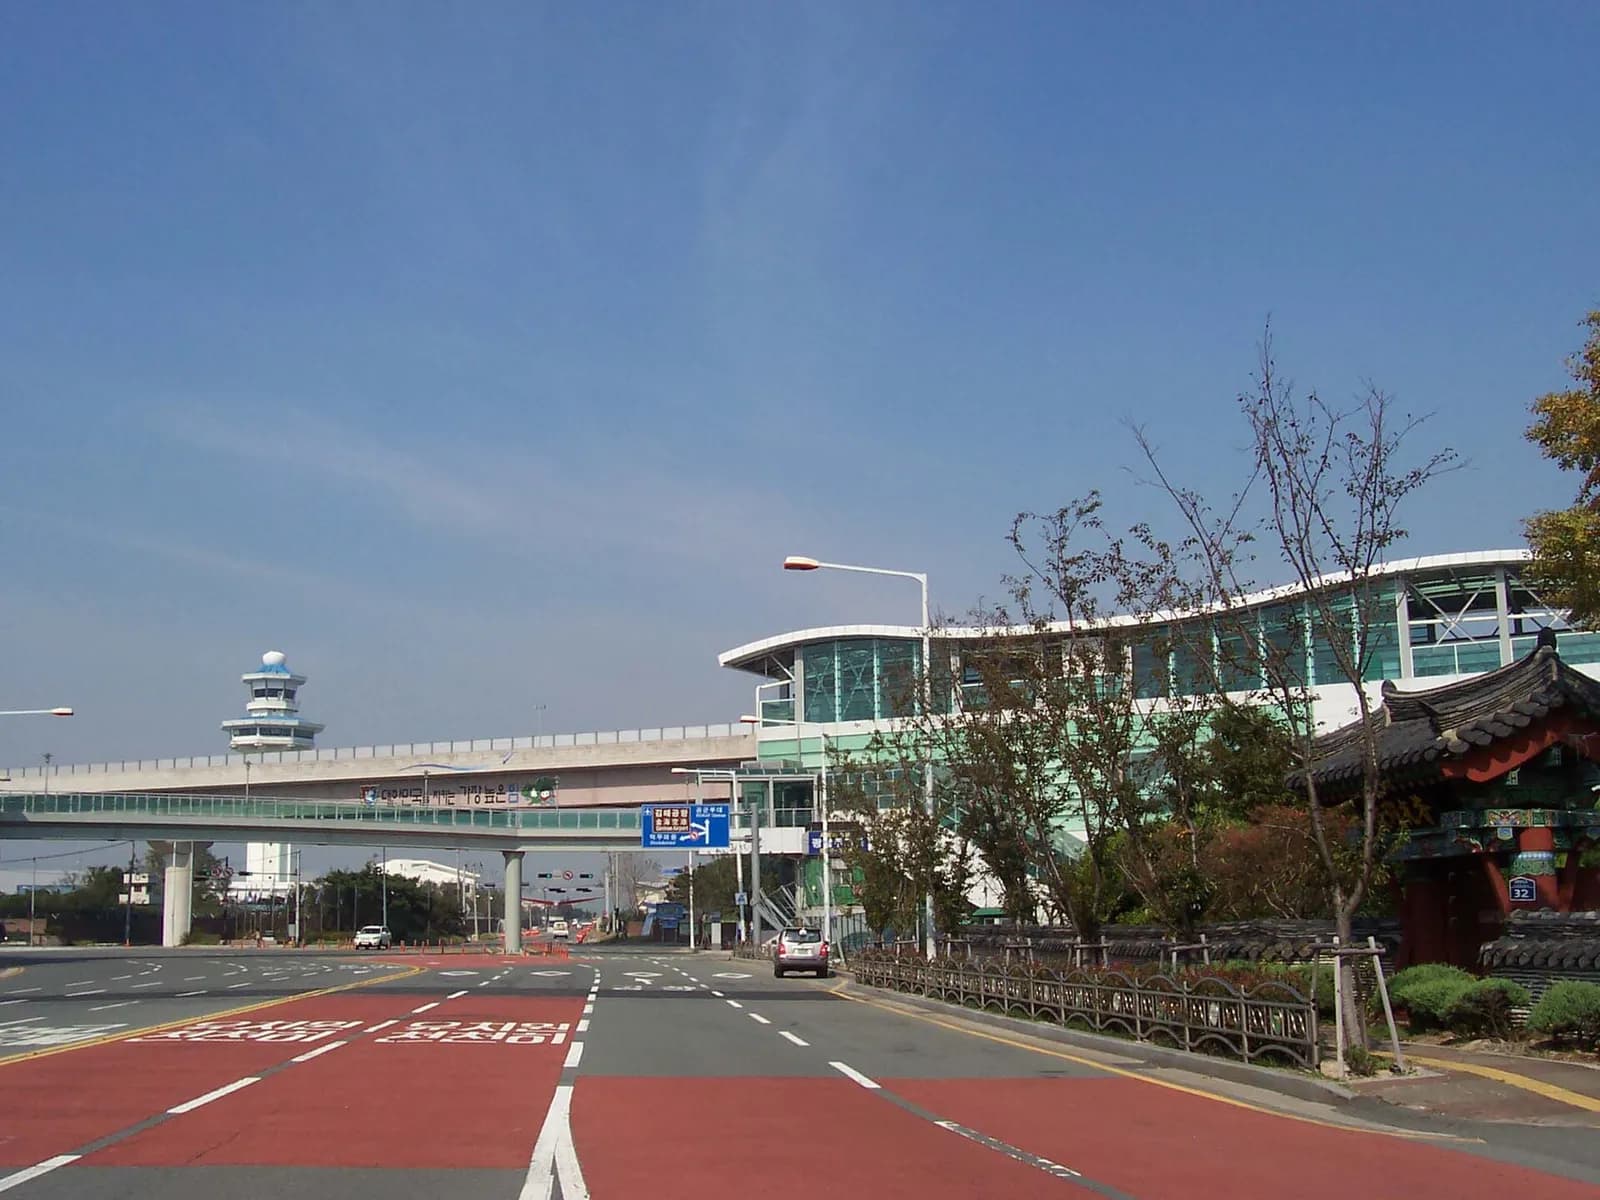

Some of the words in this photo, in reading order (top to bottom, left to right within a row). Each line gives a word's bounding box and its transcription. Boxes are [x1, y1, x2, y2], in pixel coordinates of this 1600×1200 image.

[460, 784, 481, 804] 가장
[484, 784, 506, 803] 높은
[508, 784, 519, 803] 힘
[1514, 888, 1529, 898] 32
